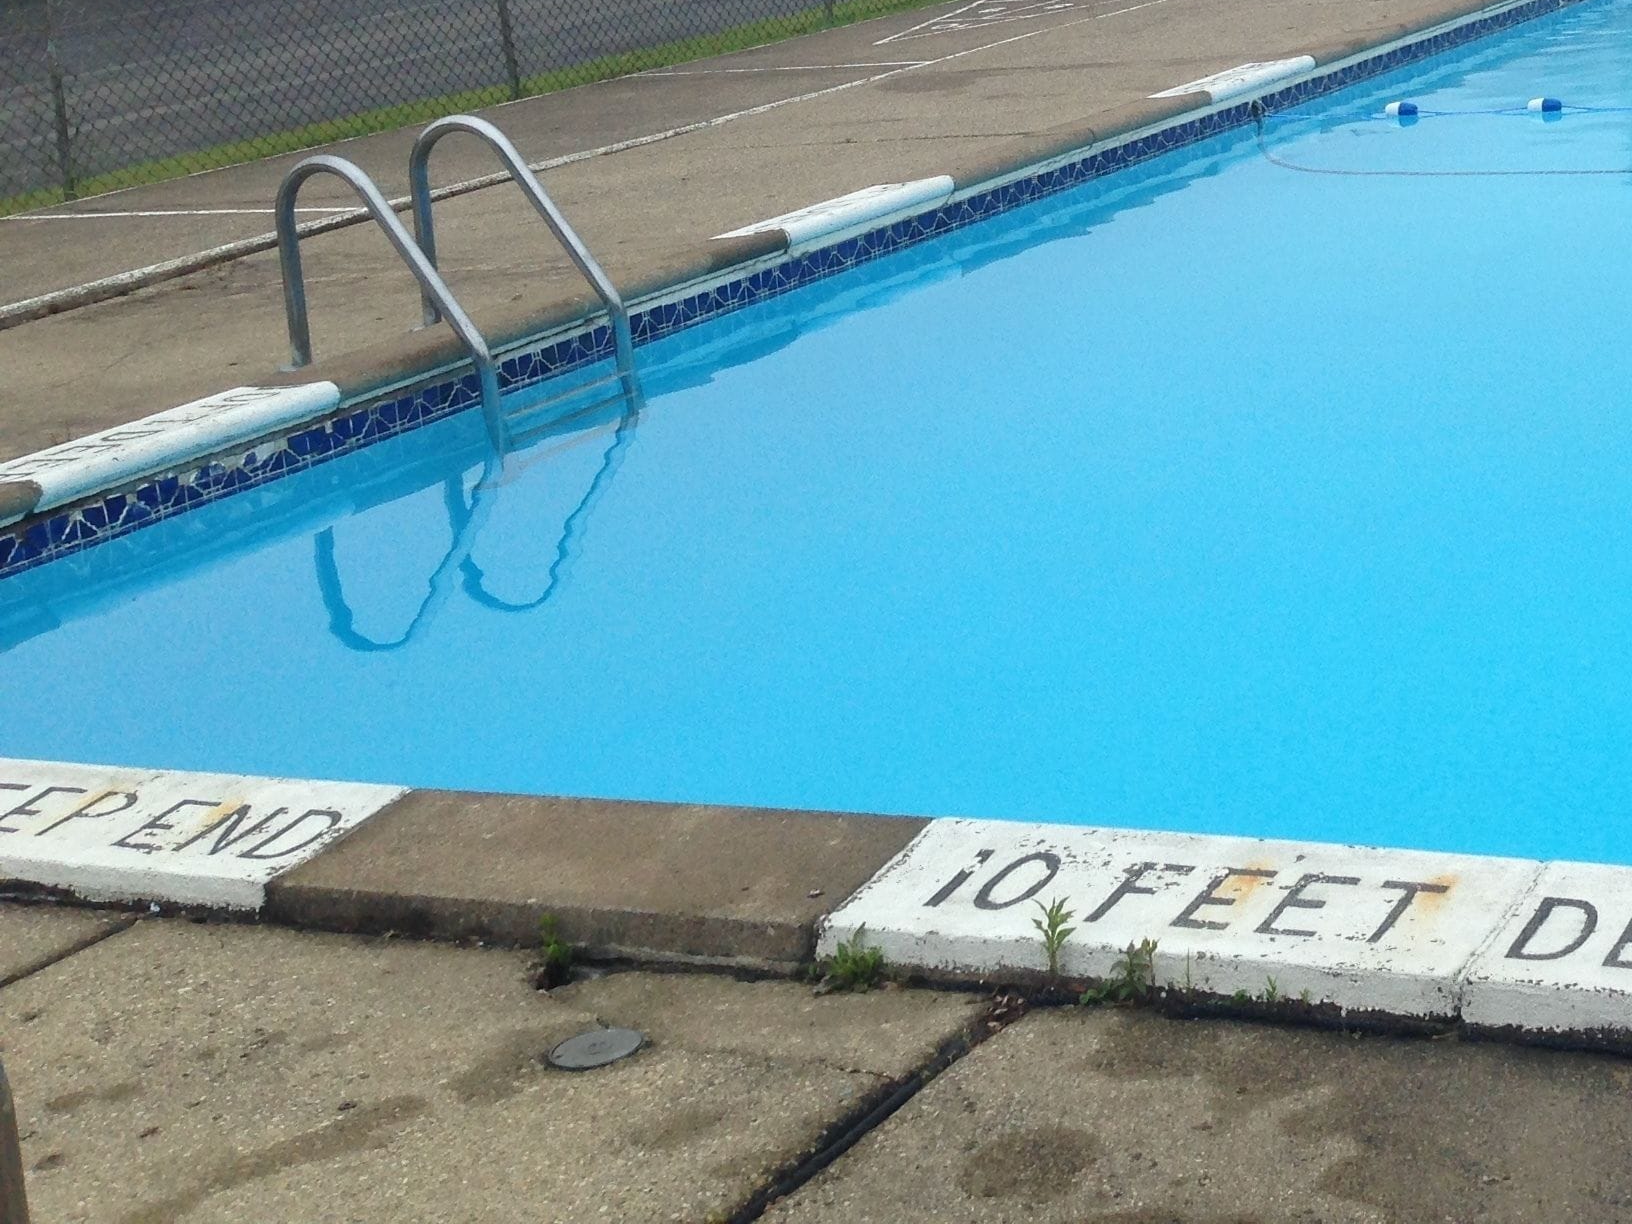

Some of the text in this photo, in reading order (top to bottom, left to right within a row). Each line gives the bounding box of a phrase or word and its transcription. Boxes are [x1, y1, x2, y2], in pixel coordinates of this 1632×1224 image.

[110, 798, 343, 860] END
[922, 848, 1062, 911] 10
[1083, 860, 1451, 944] FEET
